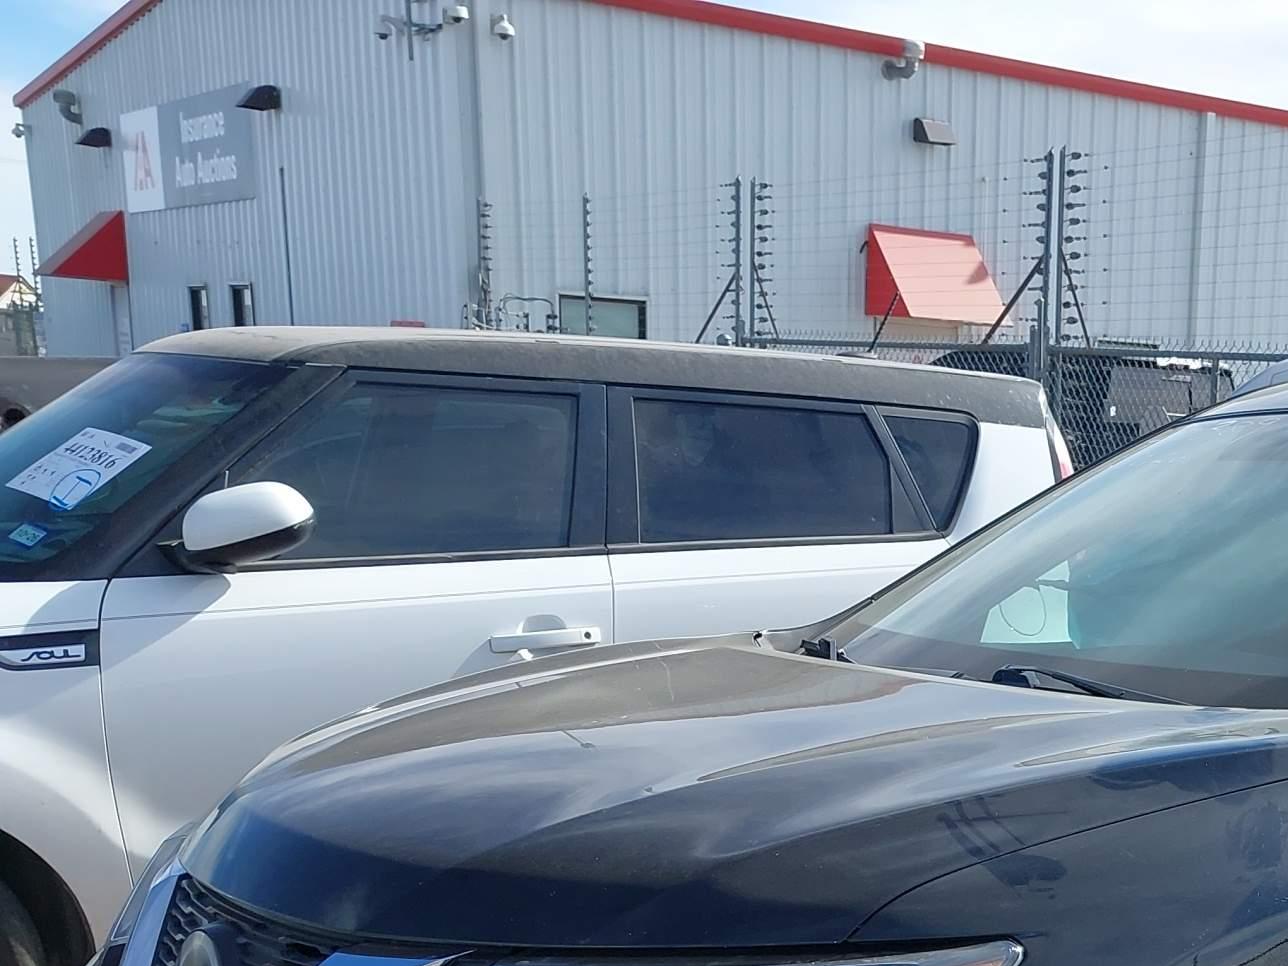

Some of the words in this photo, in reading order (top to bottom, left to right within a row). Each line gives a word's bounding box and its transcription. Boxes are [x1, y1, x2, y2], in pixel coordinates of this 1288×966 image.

[179, 111, 225, 143] Insurance
[175, 156, 195, 188] Auto
[197, 147, 238, 184] Auctions
